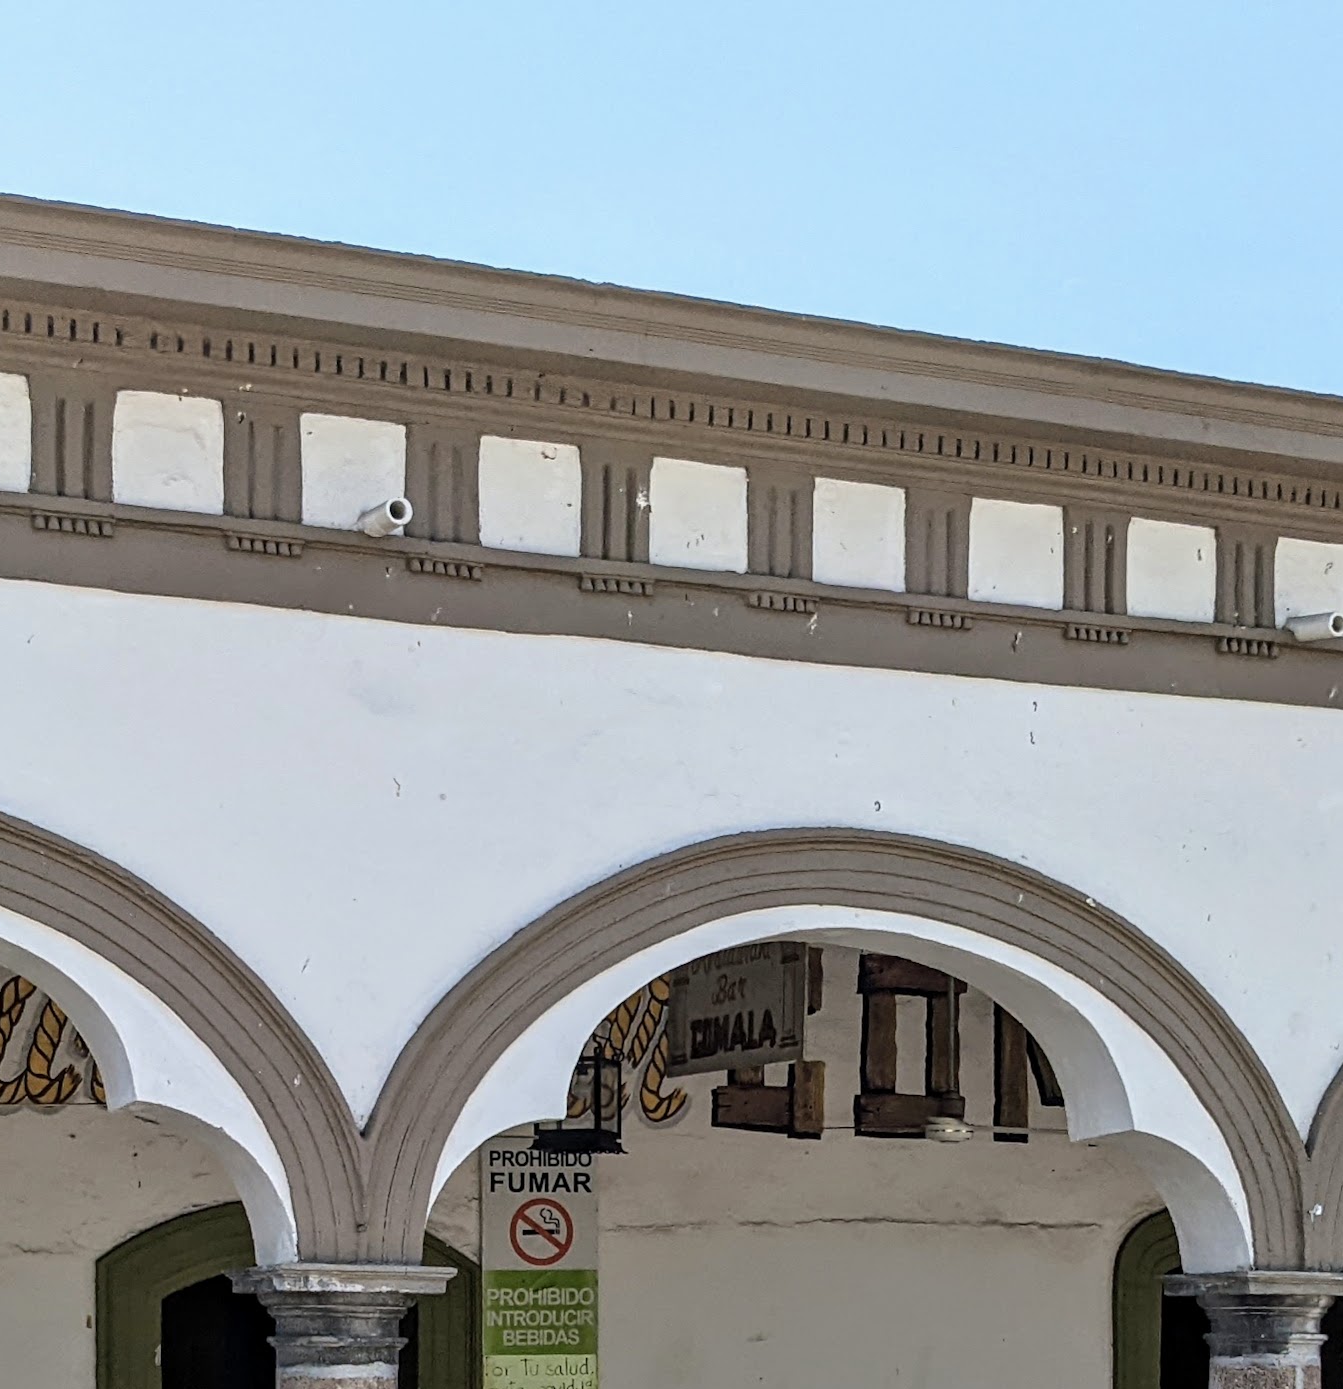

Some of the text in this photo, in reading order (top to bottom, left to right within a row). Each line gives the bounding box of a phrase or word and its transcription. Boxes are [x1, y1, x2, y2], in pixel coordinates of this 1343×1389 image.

[712, 974, 747, 1005] Bar
[690, 1009, 777, 1059] COMALA
[489, 1150, 592, 1167] PROHIBIDO
[490, 1172, 592, 1193] FUMAR
[487, 1287, 594, 1306] PROHIBIDO
[487, 1309, 594, 1326] INTRODUCIR
[502, 1329, 580, 1346] BEBIDAS
[485, 1356, 511, 1377] or
[520, 1358, 539, 1376] Tu
